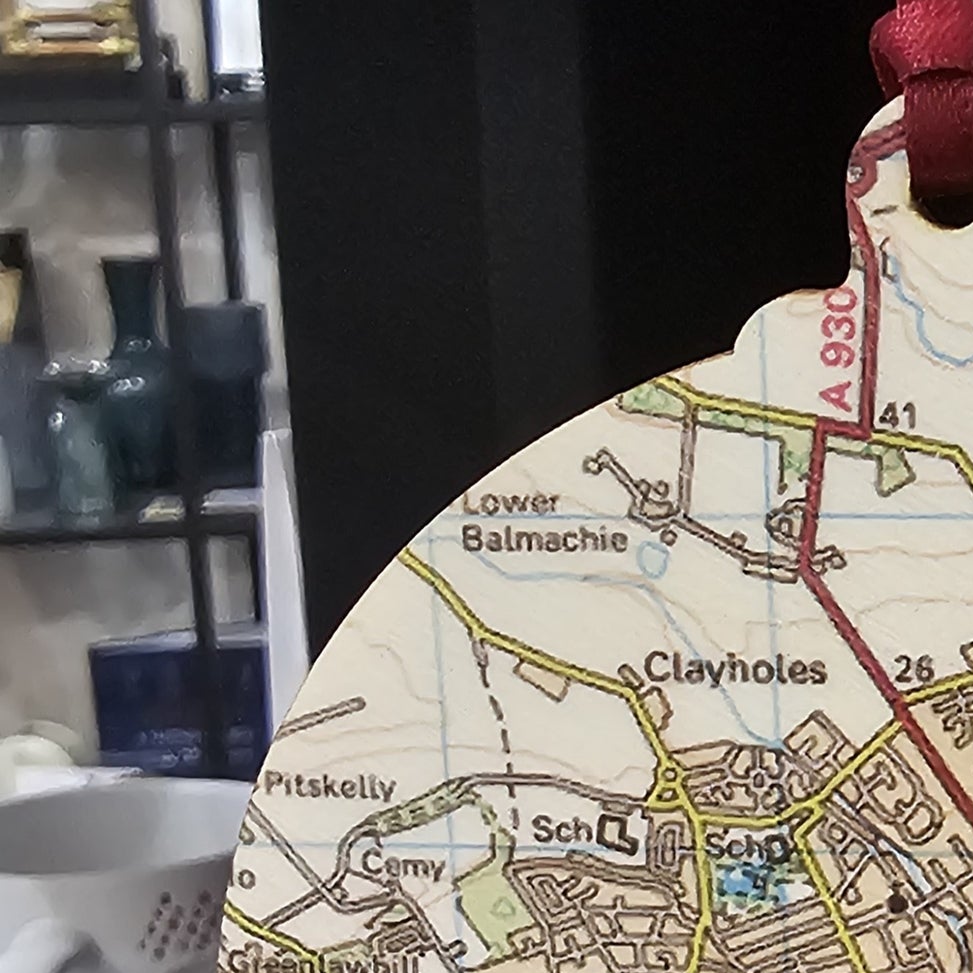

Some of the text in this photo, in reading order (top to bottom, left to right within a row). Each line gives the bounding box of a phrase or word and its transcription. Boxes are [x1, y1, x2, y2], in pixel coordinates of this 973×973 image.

[819, 286, 858, 412] A 930
[878, 402, 918, 429] 41
[462, 492, 560, 516] Lower
[461, 523, 629, 554] Balmachie
[643, 651, 829, 689] Clayholes
[893, 654, 936, 683] 26
[264, 771, 398, 802] Pitskelly
[532, 814, 594, 844] Sch
